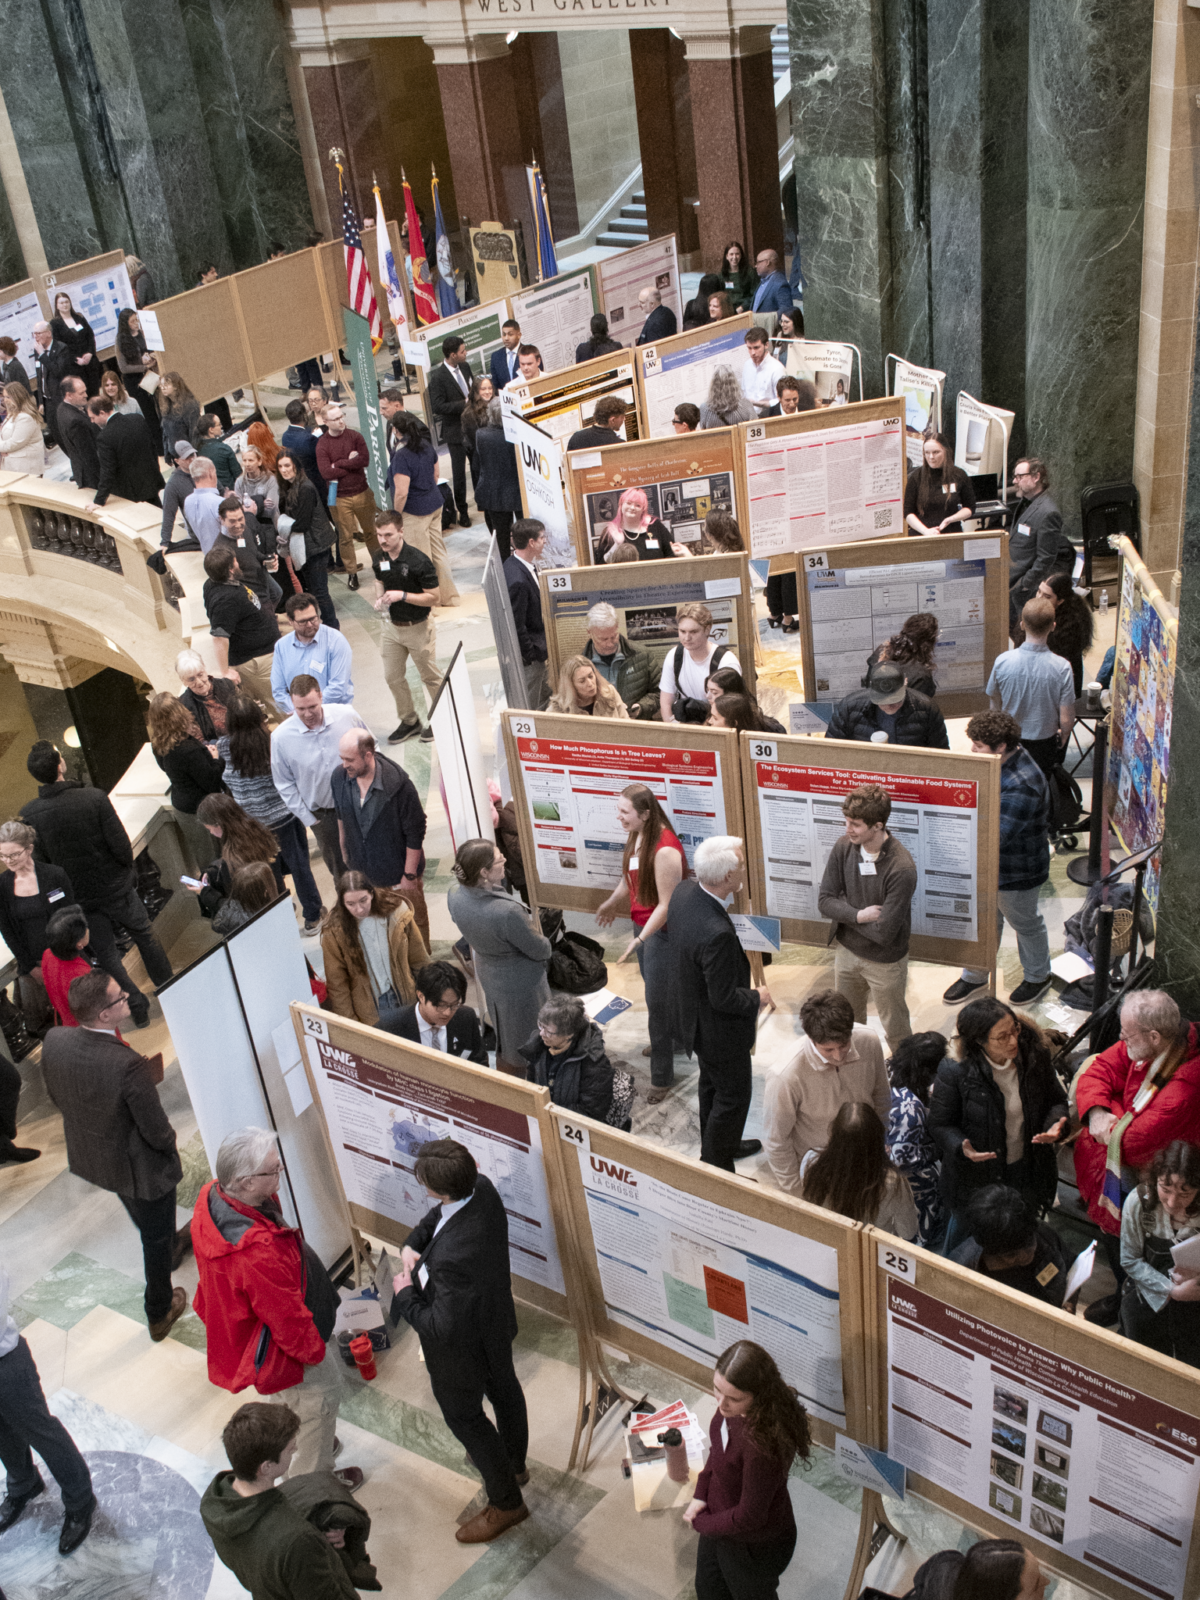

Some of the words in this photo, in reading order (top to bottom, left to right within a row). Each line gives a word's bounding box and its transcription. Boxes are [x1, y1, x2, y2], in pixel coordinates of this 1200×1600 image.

[478, 0, 536, 12] WEST
[419, 333, 426, 342] 45
[645, 350, 654, 359] 42
[645, 358, 660, 370] UWO
[908, 371, 928, 379] Mother
[502, 394, 517, 407] UWO
[963, 409, 978, 417] Better
[882, 417, 899, 426] UWO
[750, 428, 761, 438] 38
[366, 402, 389, 514] PARKSIDE
[521, 441, 550, 481] UWO
[526, 479, 555, 509] OSHKOSH
[809, 556, 824, 567] 34
[817, 570, 835, 578] UWM
[553, 577, 567, 588] 33
[598, 595, 634, 603] Accessibility
[667, 588, 702, 597] Experiences
[516, 722, 531, 734] 29
[520, 751, 549, 760] WISCONSIN
[549, 743, 562, 751] How
[563, 744, 578, 752] Much
[579, 745, 613, 756] Phosphorus
[627, 749, 640, 757] Tree
[641, 750, 665, 759] Leaves?
[755, 744, 773, 757] 30
[760, 763, 771, 771] The
[773, 764, 806, 775] Ecosystem
[807, 767, 834, 777] Services
[835, 770, 850, 779] Tool:
[851, 771, 885, 783] Cultivating
[887, 774, 924, 786] Sustainable
[925, 778, 942, 787] Food
[943, 779, 972, 791] Systems
[763, 780, 788, 788] WISCONSIN
[875, 782, 895, 790] Planet
[306, 1018, 323, 1035] 23
[323, 1060, 334, 1069] LA
[333, 1064, 359, 1079] CROSSE
[361, 1059, 392, 1074] Modulation
[399, 1073, 419, 1085] human
[449, 1091, 475, 1105] function
[386, 1074, 394, 1082] by
[408, 1082, 424, 1092] class
[564, 1124, 584, 1144] 24
[592, 1175, 603, 1186] LA
[604, 1180, 640, 1200] CROSSE
[885, 1252, 909, 1274] 25
[923, 1332, 943, 1345] Abstract
[945, 1309, 974, 1329] Utilizing
[976, 1324, 1017, 1347] Photovoice
[1018, 1343, 1027, 1352] to
[1028, 1348, 1059, 1367] Answer:
[1061, 1363, 1076, 1376] Why
[1078, 1370, 1103, 1388] Public
[1105, 1383, 1136, 1402] Health?
[1017, 1350, 1033, 1362] Emma
[959, 1330, 988, 1348] Department
[998, 1348, 1012, 1359] Public
[1014, 1355, 1032, 1368] Health
[1038, 1367, 1068, 1386] Community
[1070, 1381, 1088, 1394] Health
[1089, 1391, 1118, 1408] Education
[991, 1351, 1017, 1368] University
[1025, 1368, 1060, 1387] Wisconsin-La
[1061, 1384, 1081, 1398] Crosse
[918, 1379, 945, 1395] Background
[1025, 1381, 1044, 1394] Results
[921, 1419, 941, 1432] Methods
[1134, 1432, 1155, 1445] Results
[1171, 1428, 1197, 1447] ESG
[1118, 1511, 1150, 1530] Conclusions
